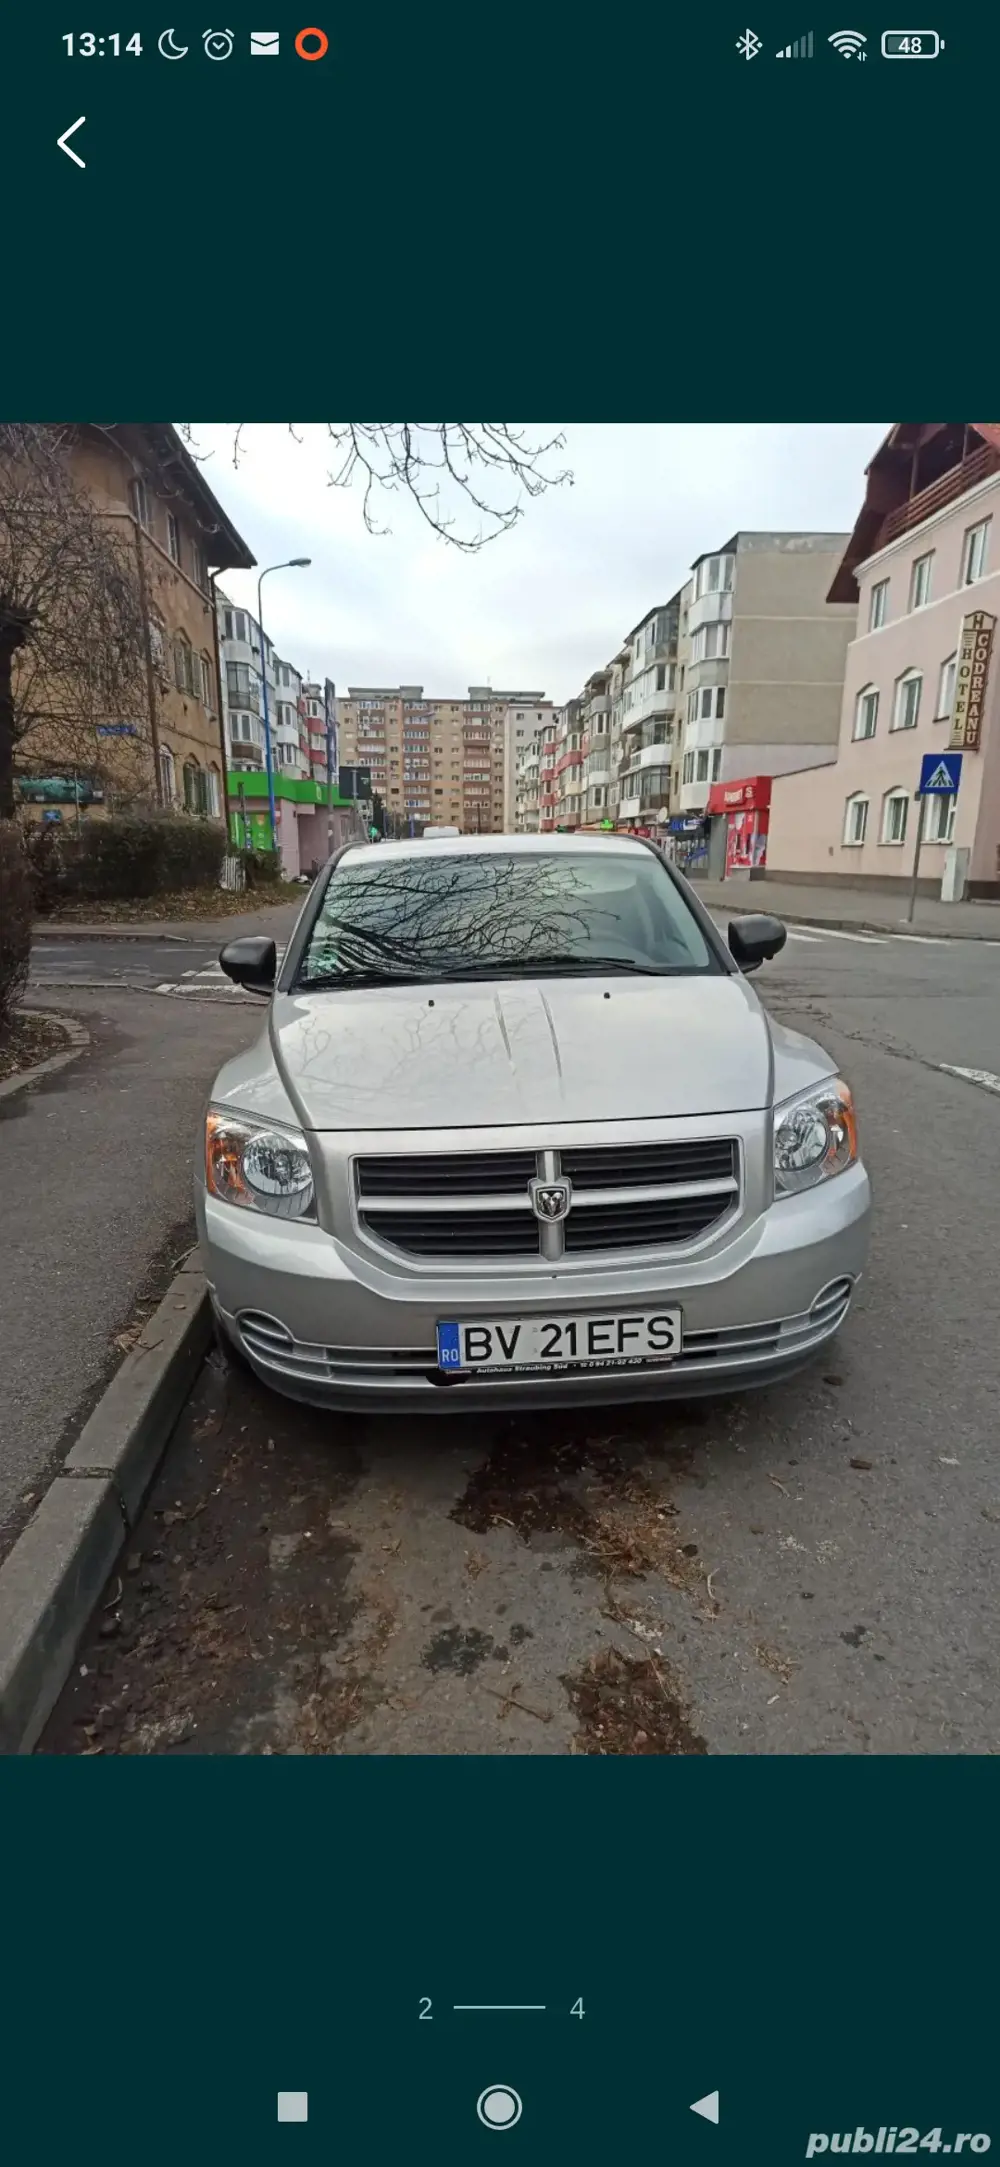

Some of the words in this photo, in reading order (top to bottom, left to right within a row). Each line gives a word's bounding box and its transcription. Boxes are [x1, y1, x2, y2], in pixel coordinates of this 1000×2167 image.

[953, 648, 974, 730] HOTEL
[966, 634, 990, 744] CODREANU
[442, 1348, 459, 1363] RO
[464, 1325, 521, 1362] BV
